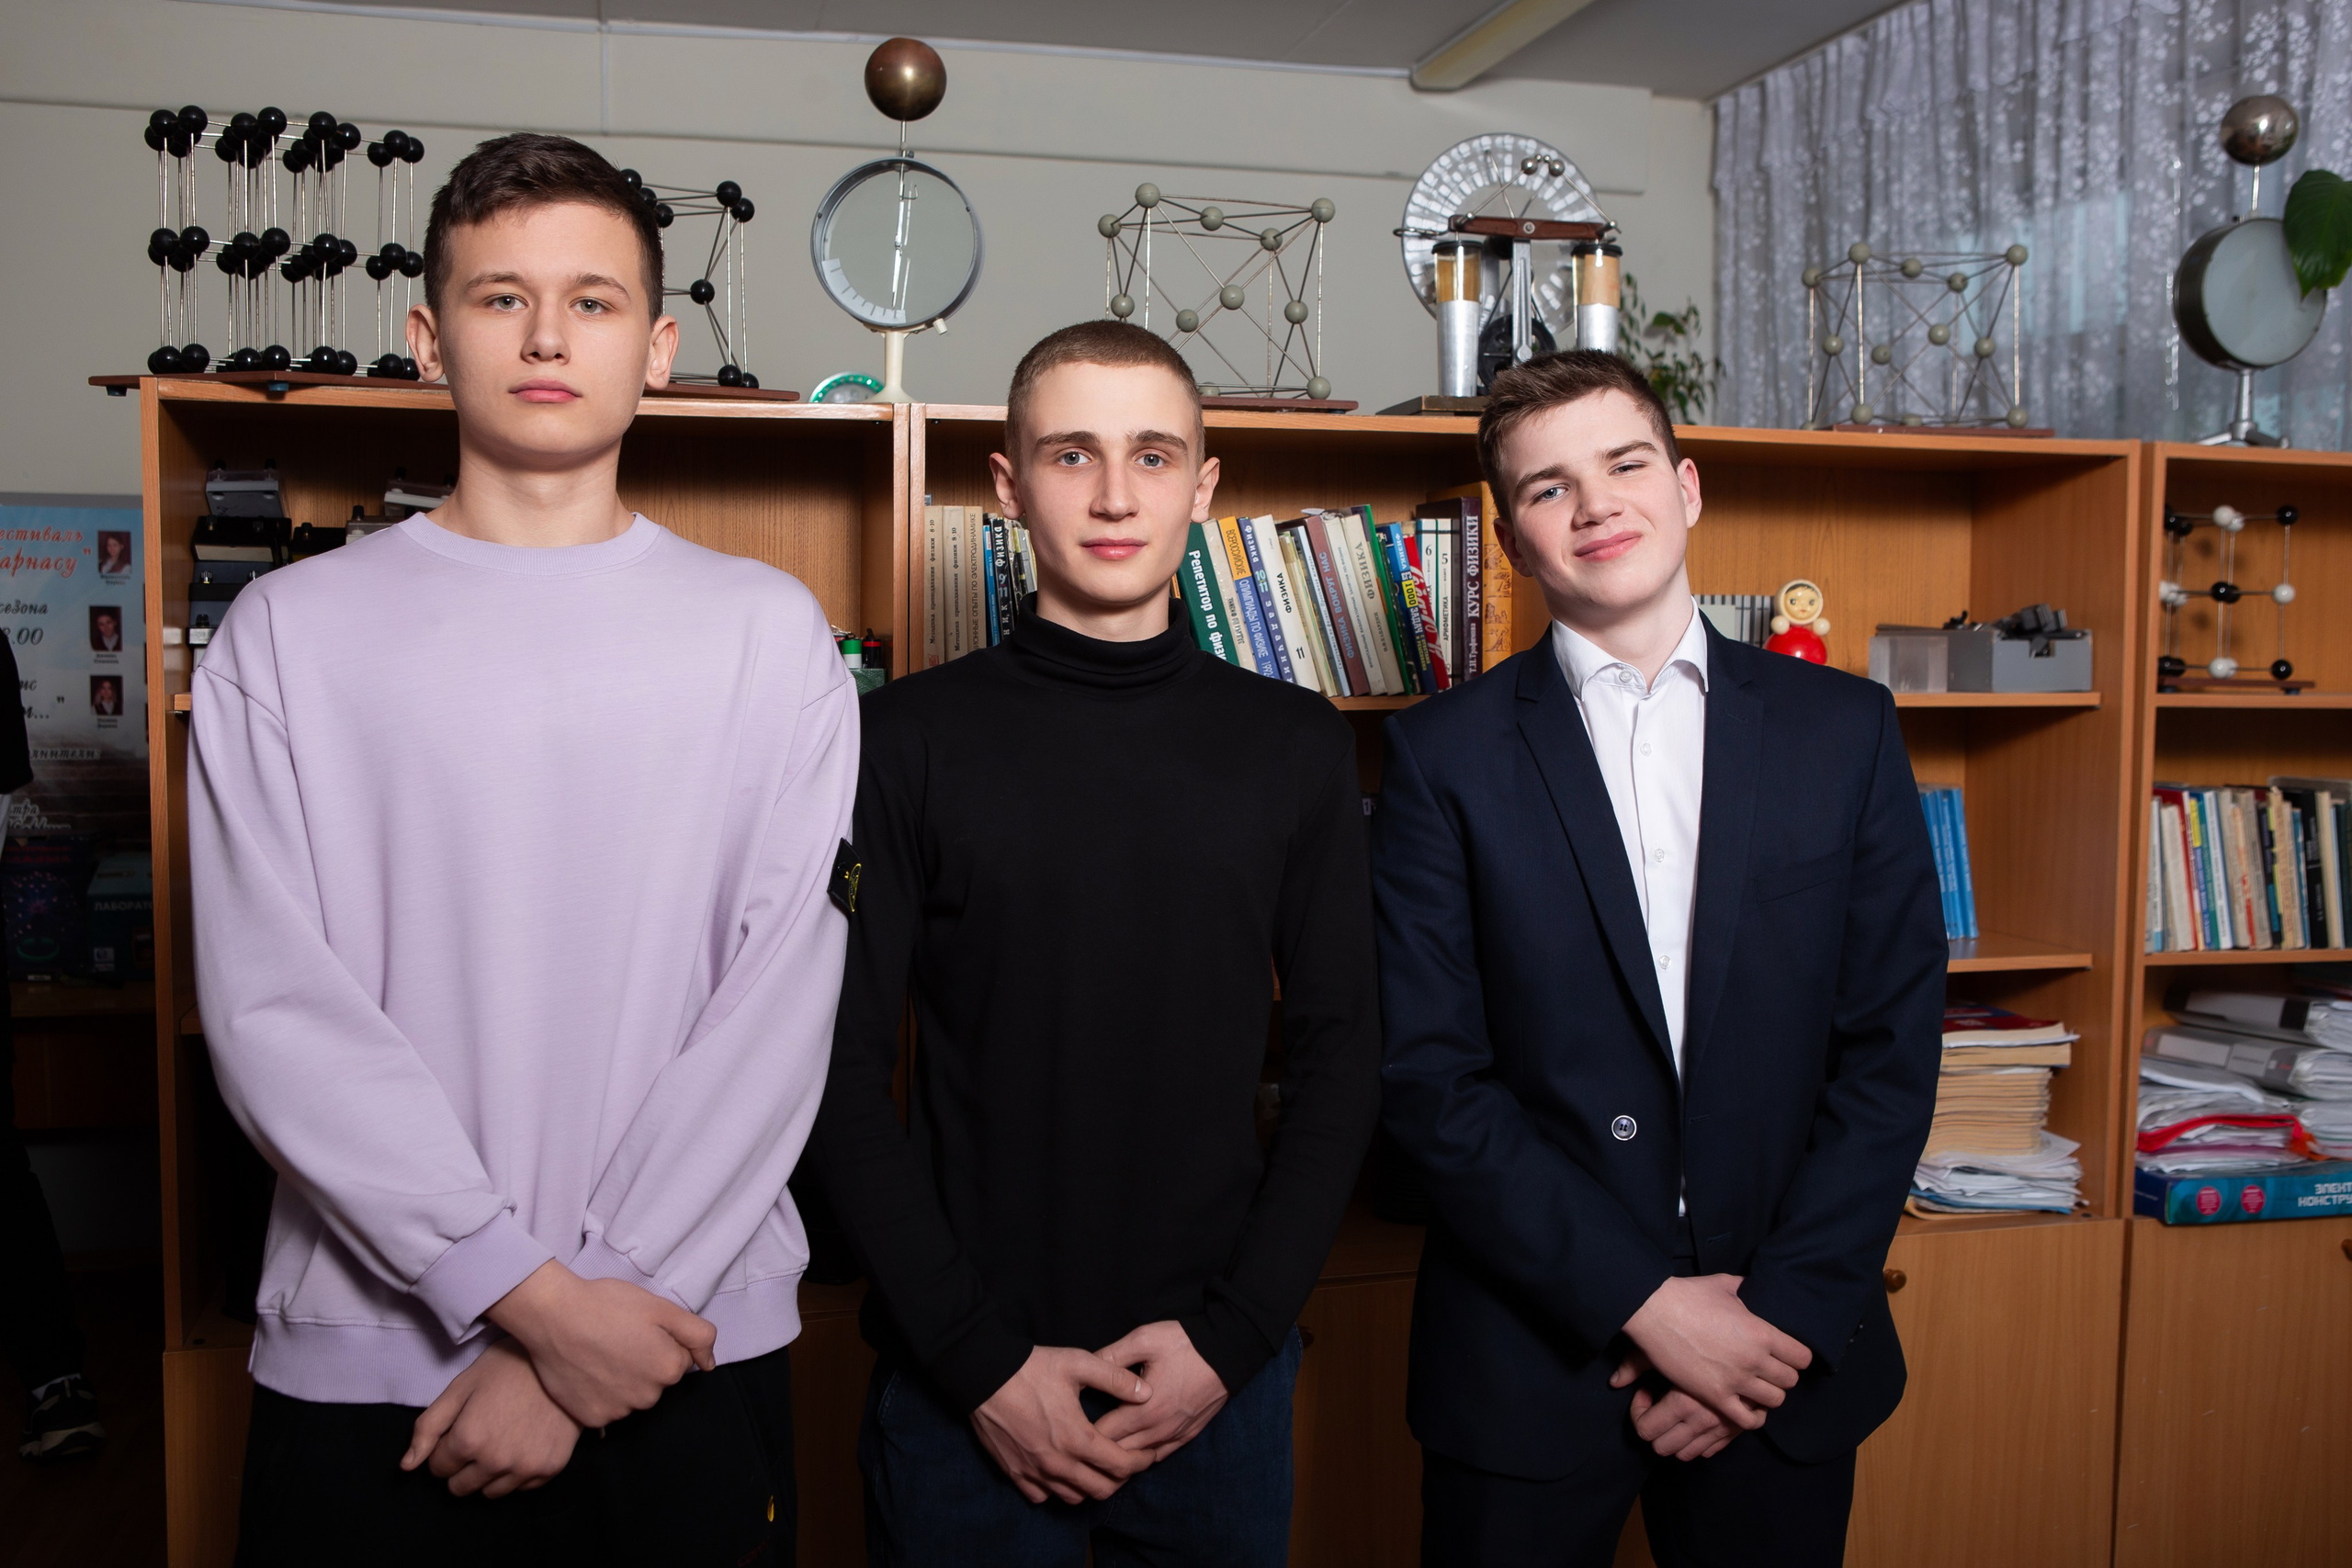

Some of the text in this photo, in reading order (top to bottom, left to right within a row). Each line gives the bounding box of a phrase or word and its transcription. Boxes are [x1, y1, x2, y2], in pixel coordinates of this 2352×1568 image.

[1226, 528, 1246, 575] ВСЕРОССИЙСКИЕ
[1425, 545, 1432, 556] 6
[1442, 553, 1448, 564] 5
[1467, 514, 1478, 578] ФИЗИКИ
[972, 581, 977, 590] ПО
[1188, 550, 1213, 612] Репетитор
[1205, 615, 1217, 629] по
[1355, 542, 1374, 600] ФИЗИКА
[1238, 580, 1257, 621] ОЛИМПИАДЫ
[1276, 573, 1292, 613] ФИЗИКА
[1319, 551, 1354, 659] ФИЗИКА ВОКРУГ НАС
[1406, 582, 1422, 634] 1000 ЗАДАЧ
[1467, 581, 1480, 618] КУРС
[1250, 621, 1260, 632] ПО
[1252, 632, 1268, 658] ФИЗИКЕ
